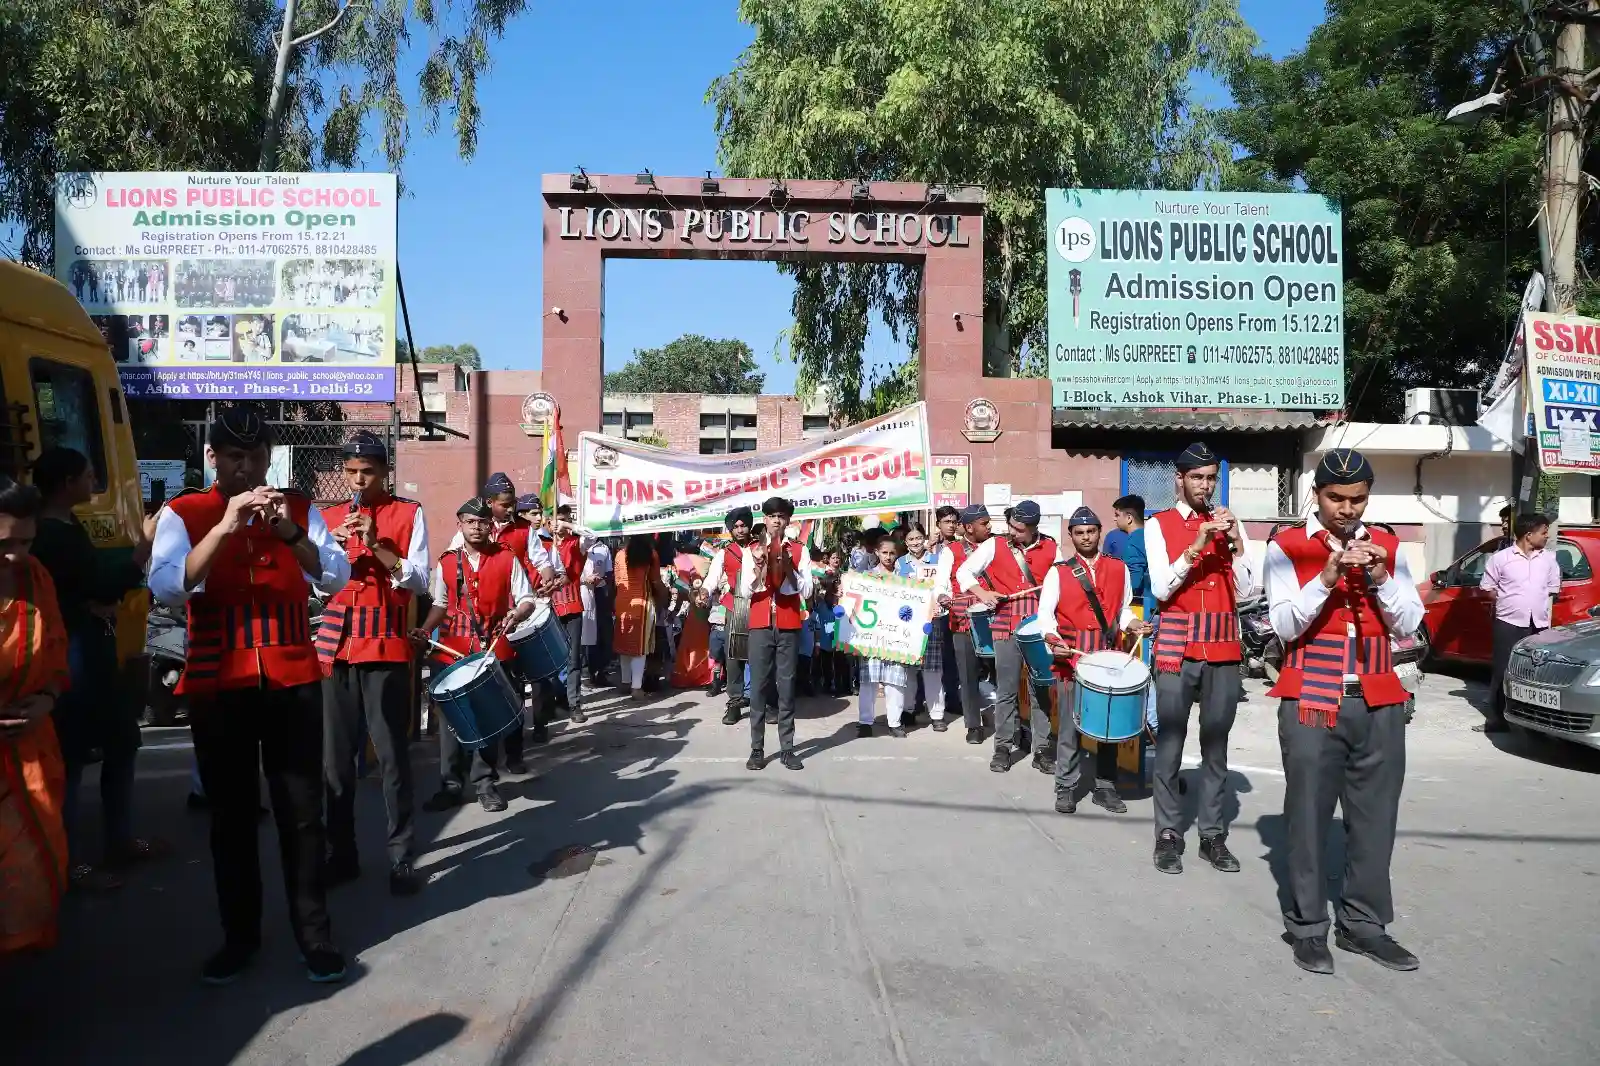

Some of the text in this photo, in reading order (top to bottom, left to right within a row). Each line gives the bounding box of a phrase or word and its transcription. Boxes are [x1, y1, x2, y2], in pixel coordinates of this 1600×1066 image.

[188, 175, 299, 185] Nurture Your Talent
[106, 188, 381, 208] LIONS PUBLIC SCHOOL
[1155, 201, 1269, 216] Nurture Your Talent
[133, 210, 356, 230] Admission Open
[558, 206, 969, 247] LIONS PUBLIC SCHOOL
[142, 231, 345, 243] Registration Opens From 15.12.21
[1061, 228, 1091, 250] lps
[1100, 220, 1338, 264] LIONS PUBLIC SCHOOL
[74, 245, 115, 255] Contact
[125, 246, 140, 255] Ms
[144, 245, 204, 255] GURPREET
[239, 245, 312, 257] 011-47062575,
[315, 245, 377, 255] 8810428485
[1105, 273, 1336, 308] Admission Open
[1090, 310, 1339, 335] Registration Opens From 15.12.21
[1056, 344, 1095, 361] Contact
[1105, 344, 1120, 362] Ms
[1123, 344, 1182, 362] GURPREET
[1279, 346, 1339, 365] 8810428485
[157, 371, 177, 381] Apply
[179, 372, 185, 380] at
[1137, 374, 1154, 386] Apply
[1537, 366, 1573, 378] ADMISSION
[1575, 370, 1591, 380] OPEN
[145, 383, 191, 394] Ashok
[194, 383, 238, 395] Vihar,
[244, 383, 305, 395] Phase-1,
[310, 383, 373, 394] Delhi-52
[1548, 381, 1598, 404] XI-XII
[1063, 391, 1340, 406] I-Block, Ashok Vihar, Phase-1, Delhi-52
[589, 449, 919, 505] LIONS PUBLIC SCHOOL
[823, 490, 887, 505] Delhi-52
[937, 499, 961, 507] MASK
